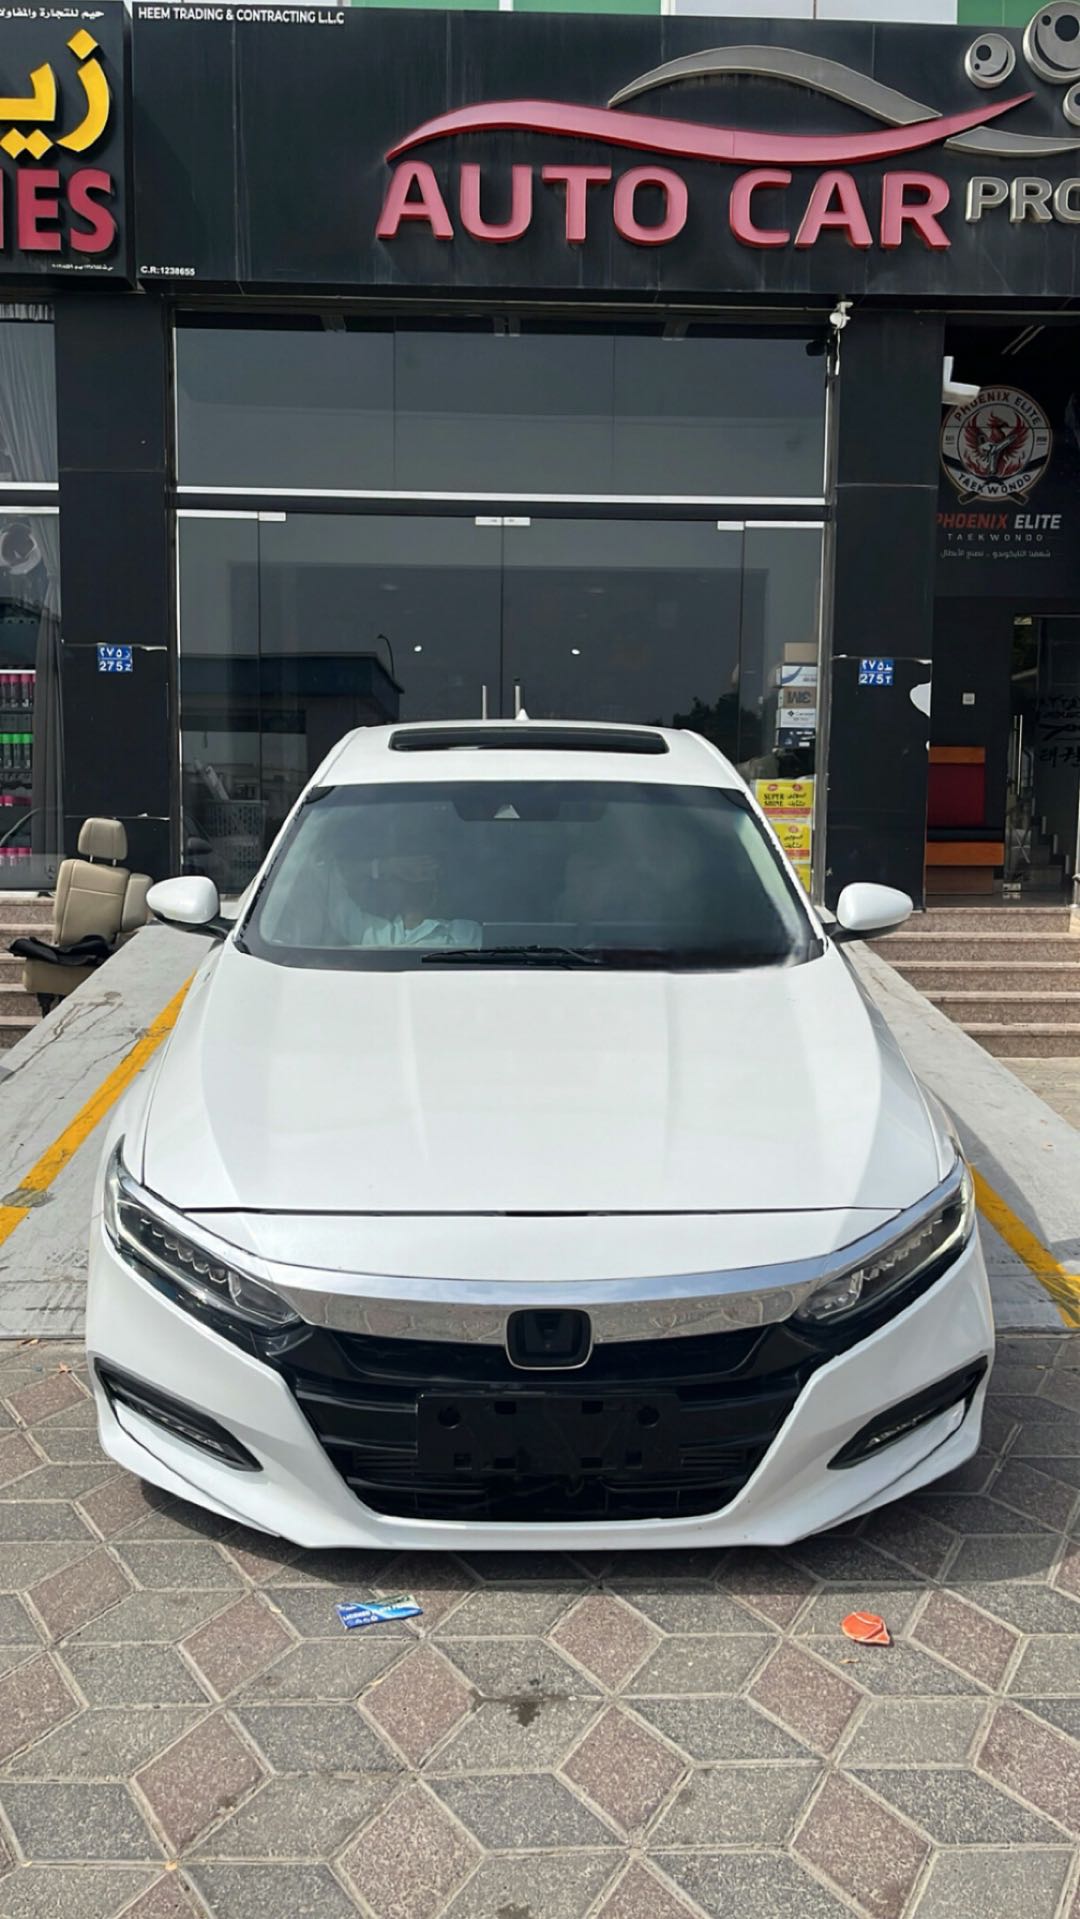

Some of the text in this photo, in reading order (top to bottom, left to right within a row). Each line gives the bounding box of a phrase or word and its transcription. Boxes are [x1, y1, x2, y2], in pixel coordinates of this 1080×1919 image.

[138, 7, 345, 24] HEEM TRADING & CONTRACTING L.L.C
[0, 168, 117, 253] ES
[375, 160, 689, 247] AUTO
[728, 168, 952, 250] CAR
[1014, 396, 1042, 426] ELITE
[958, 473, 1032, 495] TAEKWONDO
[1014, 514, 1062, 529] ELITE
[947, 533, 1043, 542] TAEKWONDO
